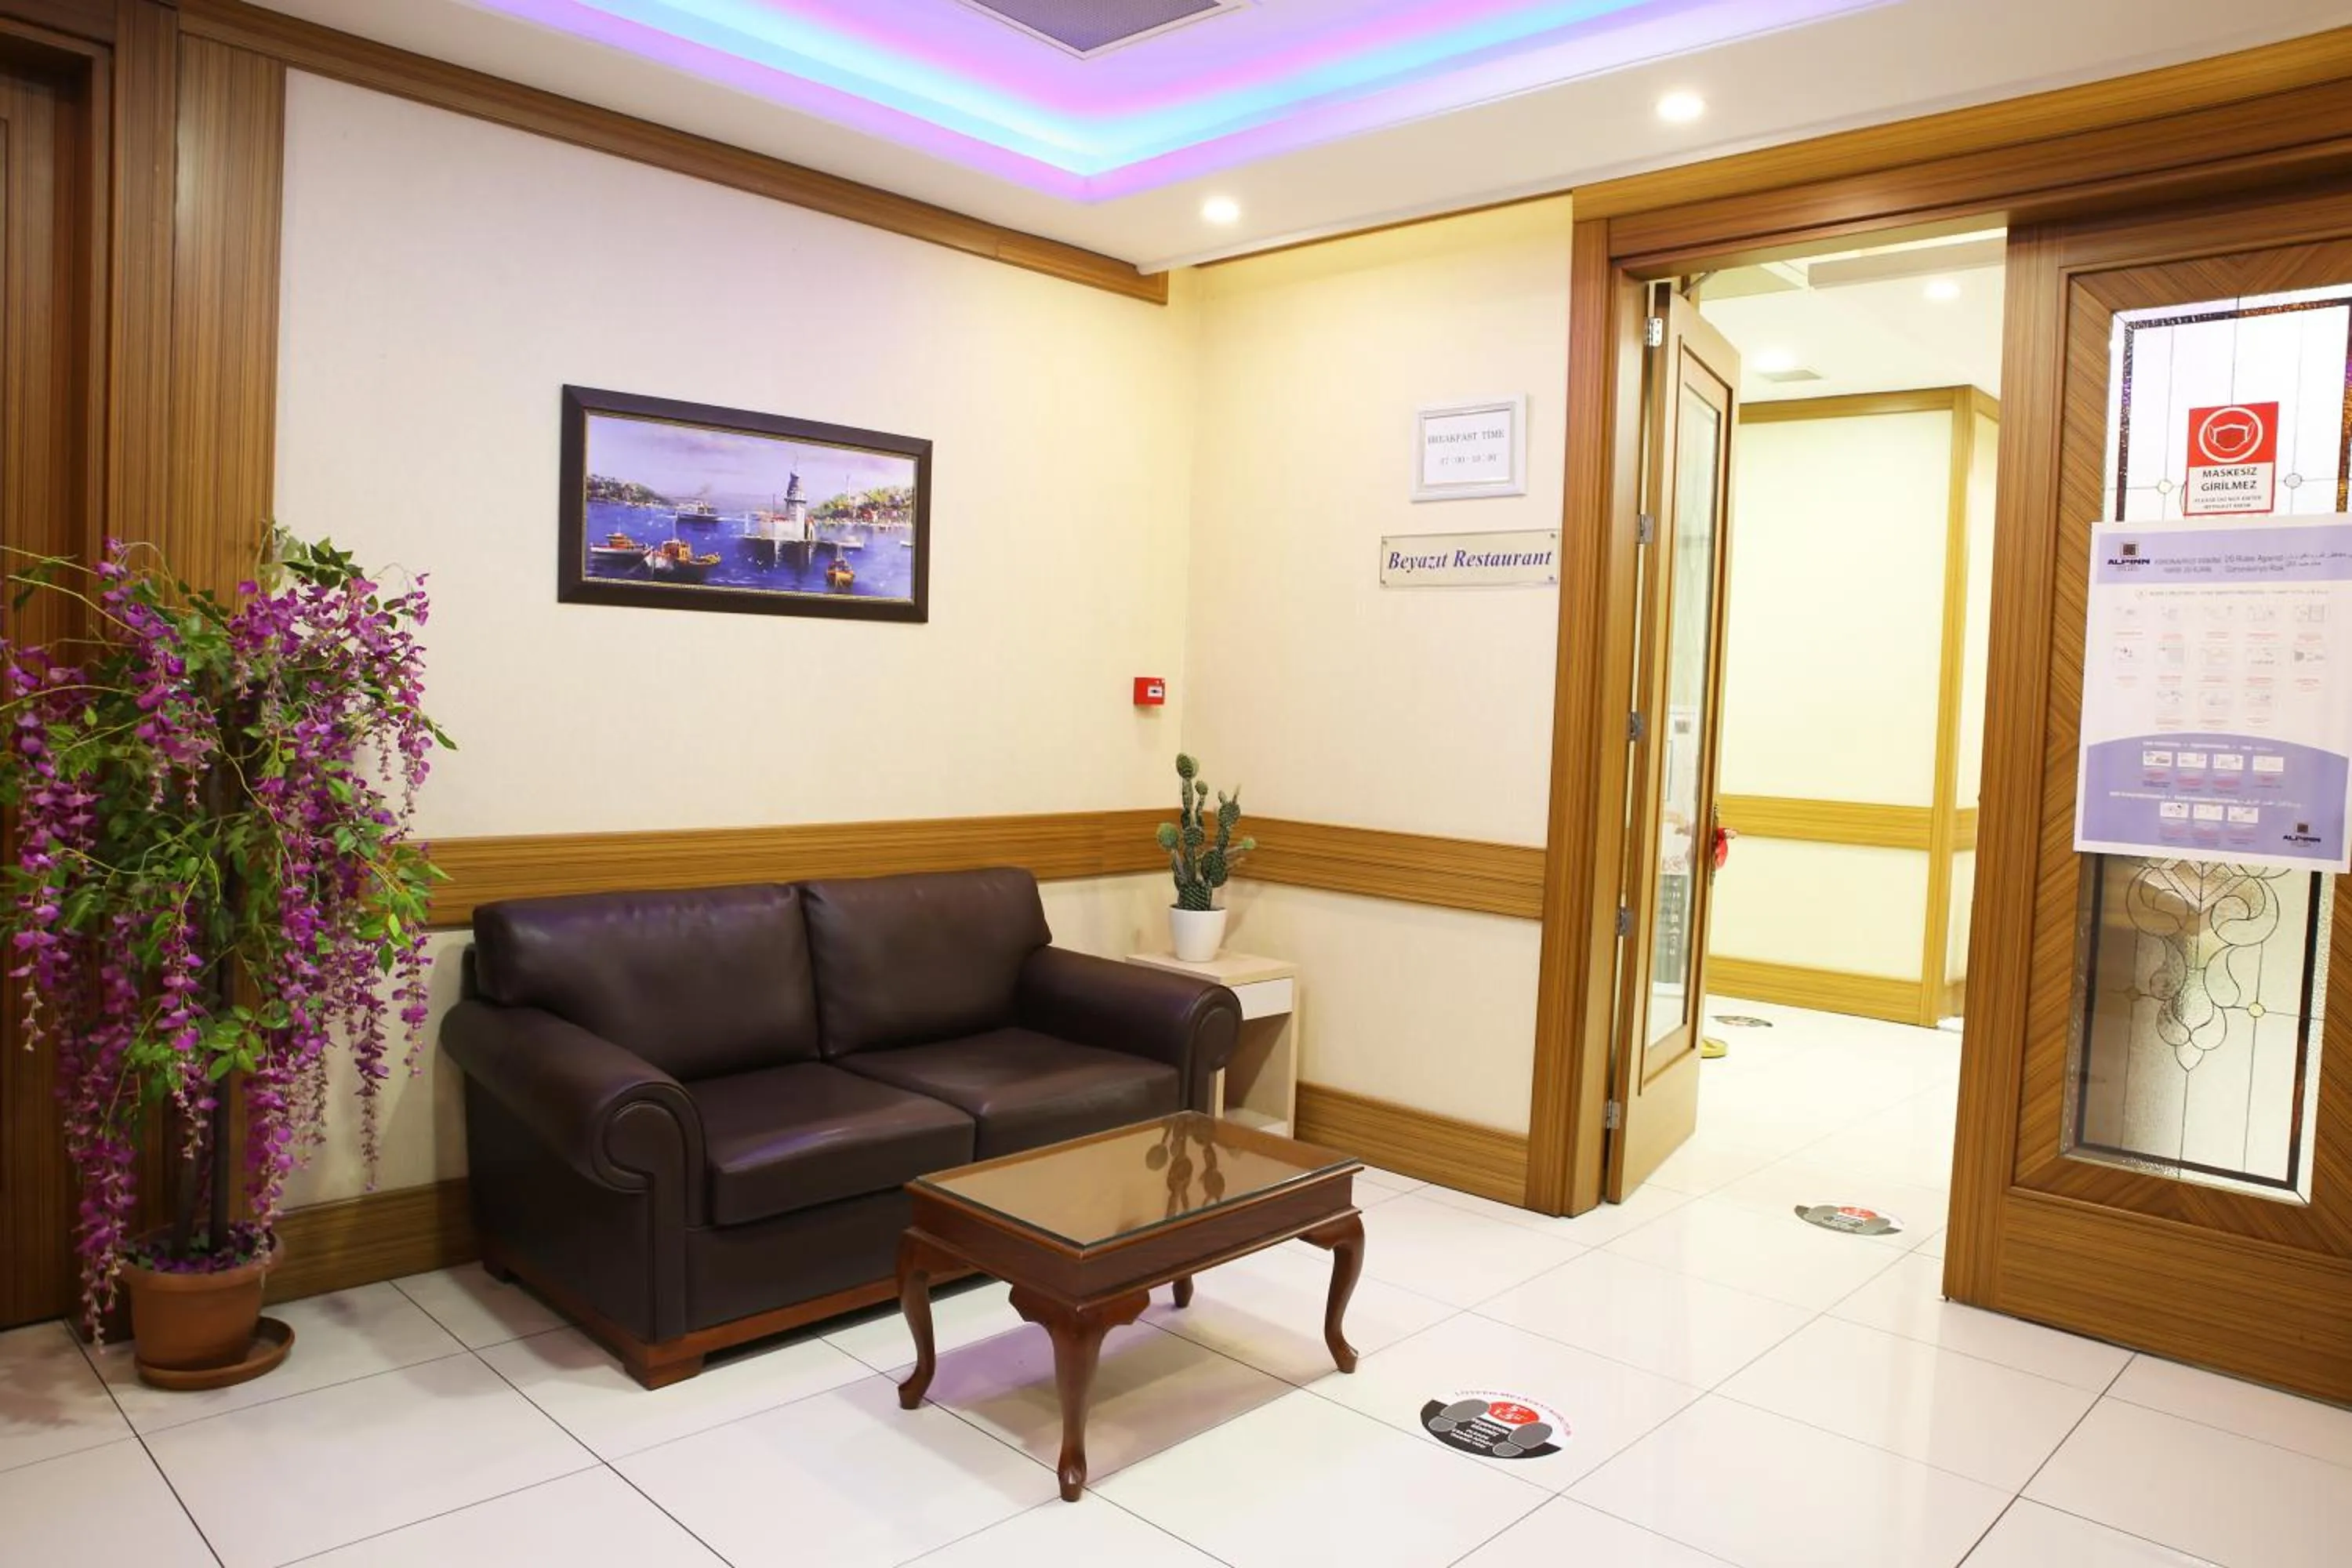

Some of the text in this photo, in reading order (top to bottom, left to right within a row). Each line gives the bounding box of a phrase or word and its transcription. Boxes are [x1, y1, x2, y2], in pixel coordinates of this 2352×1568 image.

[2202, 466, 2258, 478] MASKESİZ
[2201, 479, 2257, 492] GİRİLMEZ
[1388, 549, 1552, 573] Beyazıt Restaurant
